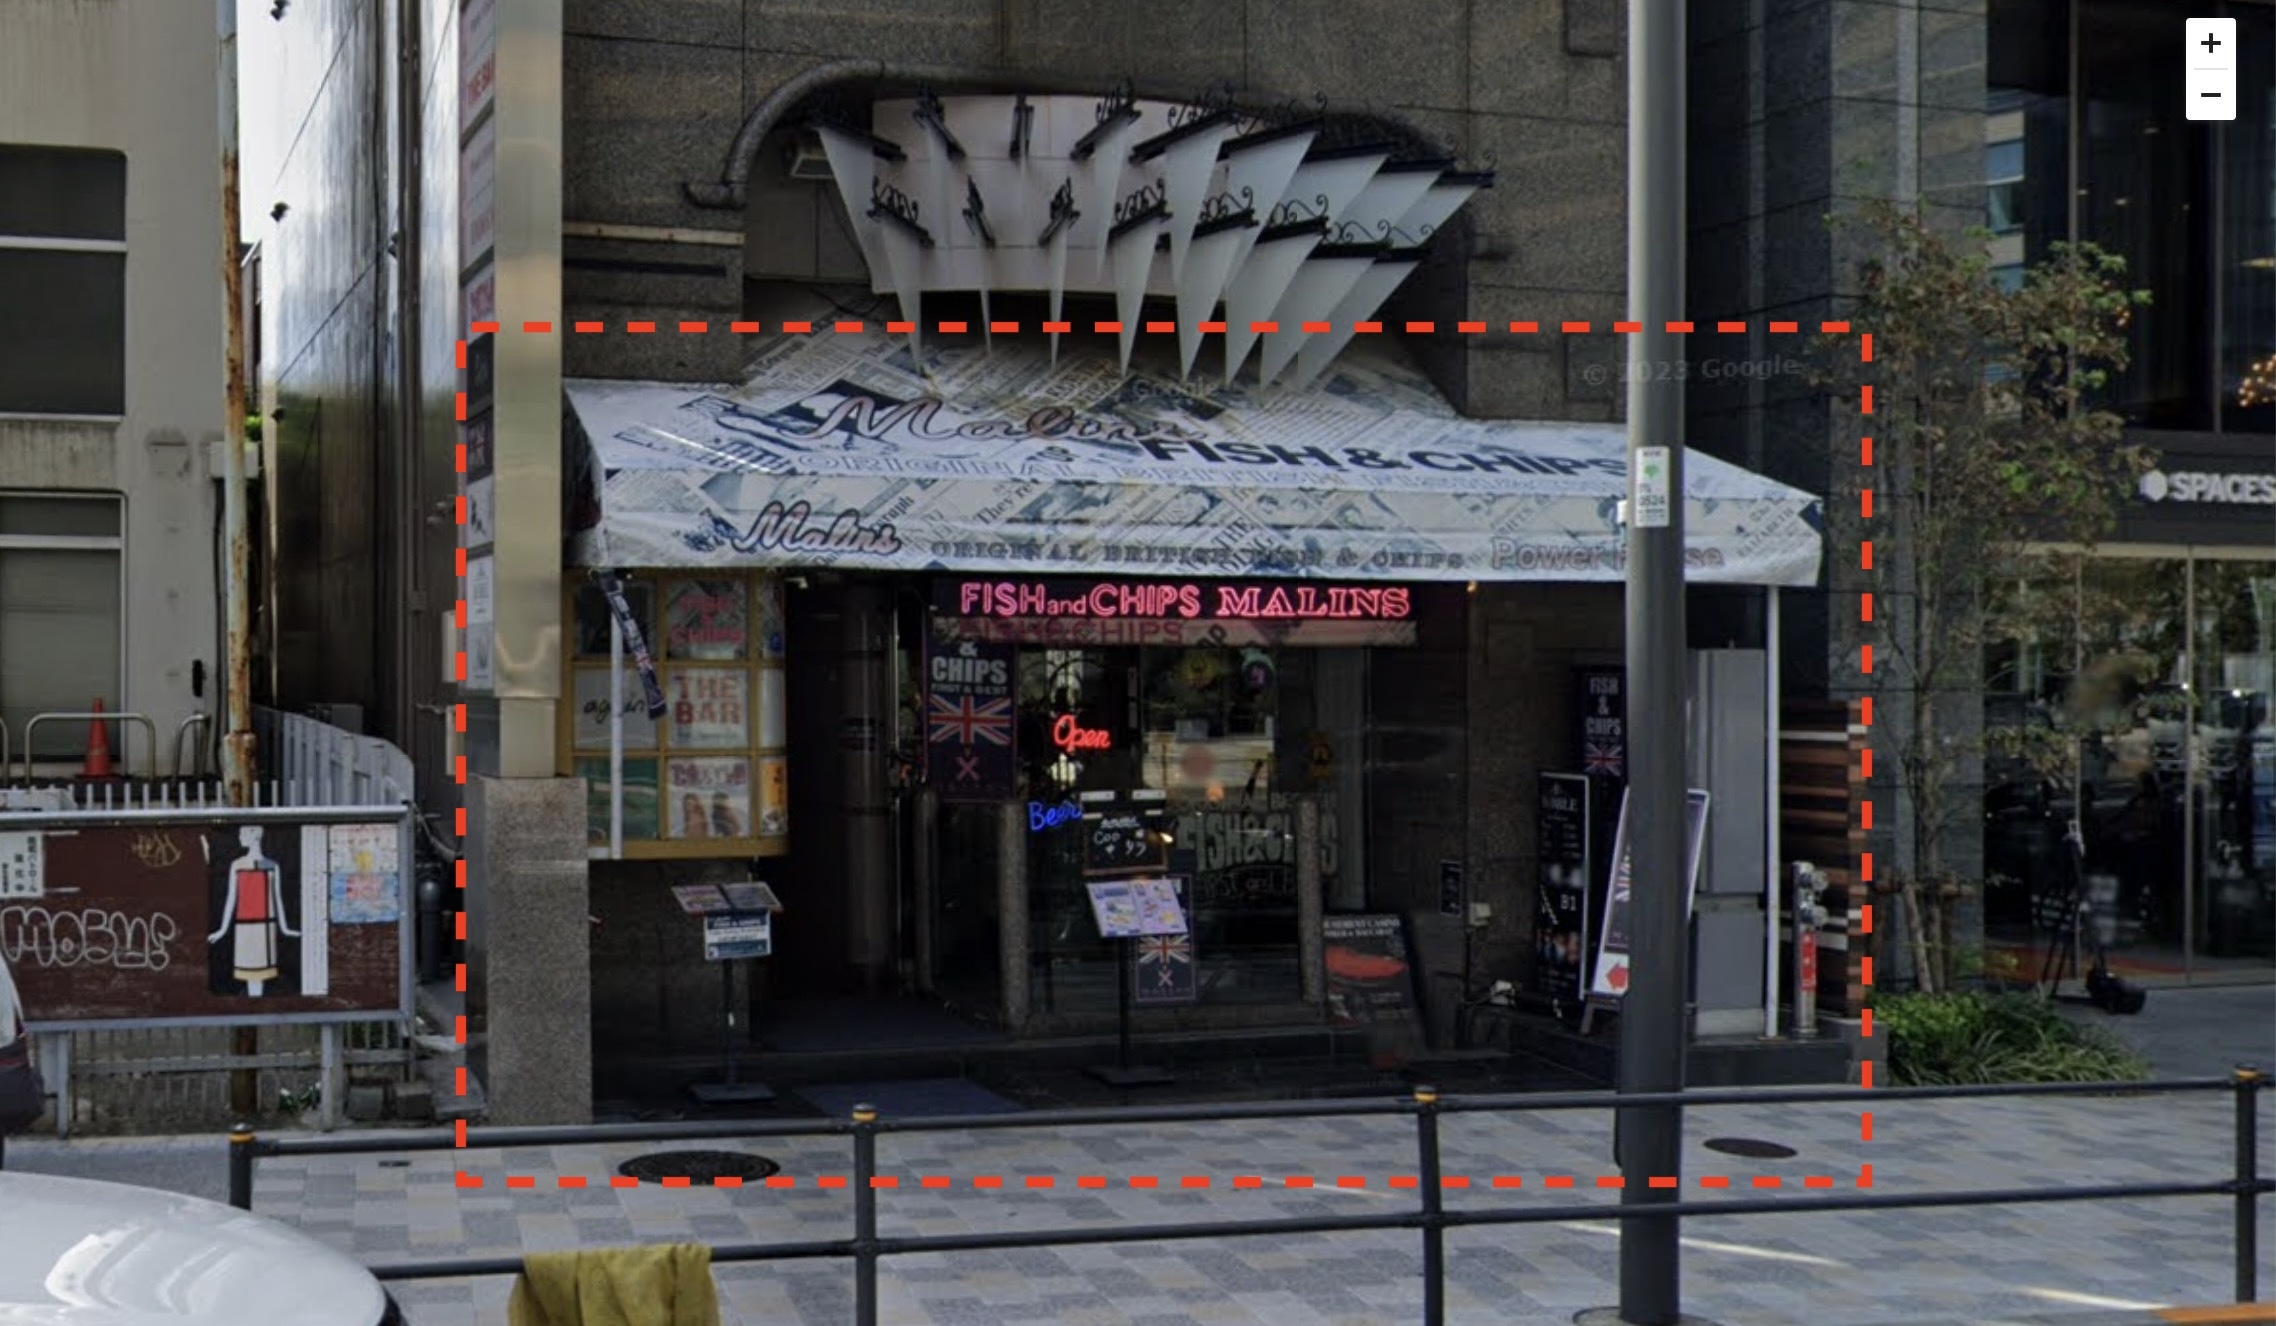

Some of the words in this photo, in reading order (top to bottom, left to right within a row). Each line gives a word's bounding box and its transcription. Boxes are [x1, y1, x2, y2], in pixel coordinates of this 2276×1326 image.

[1138, 438, 1343, 467] FISH
[1407, 450, 1628, 477] CHIPS
[2167, 473, 2276, 502] SPACES
[731, 499, 903, 555] Malins
[931, 541, 1086, 561] ORIGINAL
[1371, 547, 1464, 569] CHIPS
[1490, 535, 1602, 571] Power
[1610, 537, 1726, 571] Hse
[960, 581, 1046, 616] FISH
[1047, 595, 1087, 616] and
[1089, 582, 1202, 618] CHIPS
[1216, 584, 1411, 618] MALINS
[958, 641, 978, 657] &
[931, 656, 1008, 685] CHIPS
[672, 675, 740, 699] THE
[1590, 676, 1619, 695] FISH
[674, 700, 742, 726] BAR
[1598, 696, 1609, 715] &
[1053, 713, 1112, 757] Open
[1585, 716, 1621, 736] CHIPS
[1029, 799, 1082, 832] Beer
[1560, 894, 1577, 911] B1
